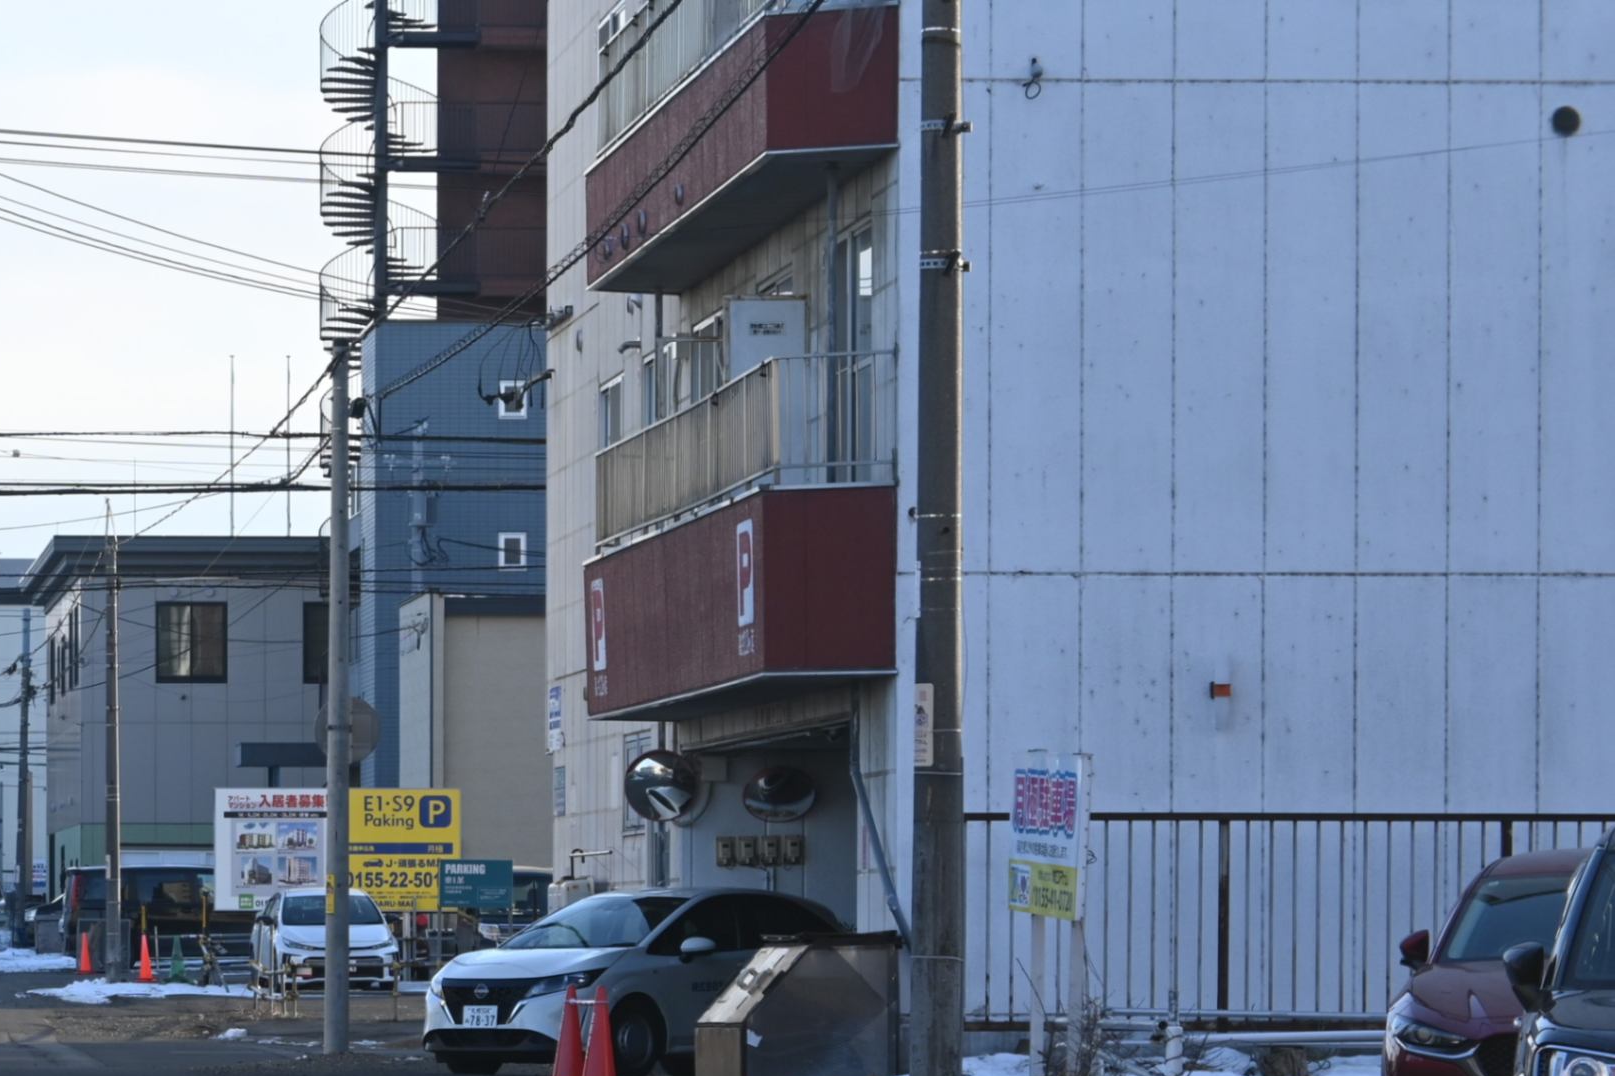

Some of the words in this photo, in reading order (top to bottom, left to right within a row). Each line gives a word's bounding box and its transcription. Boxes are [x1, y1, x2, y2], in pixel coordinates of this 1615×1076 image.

[428, 800, 447, 824] P
[364, 813, 415, 830] Paking
[444, 863, 487, 875] PARKING
